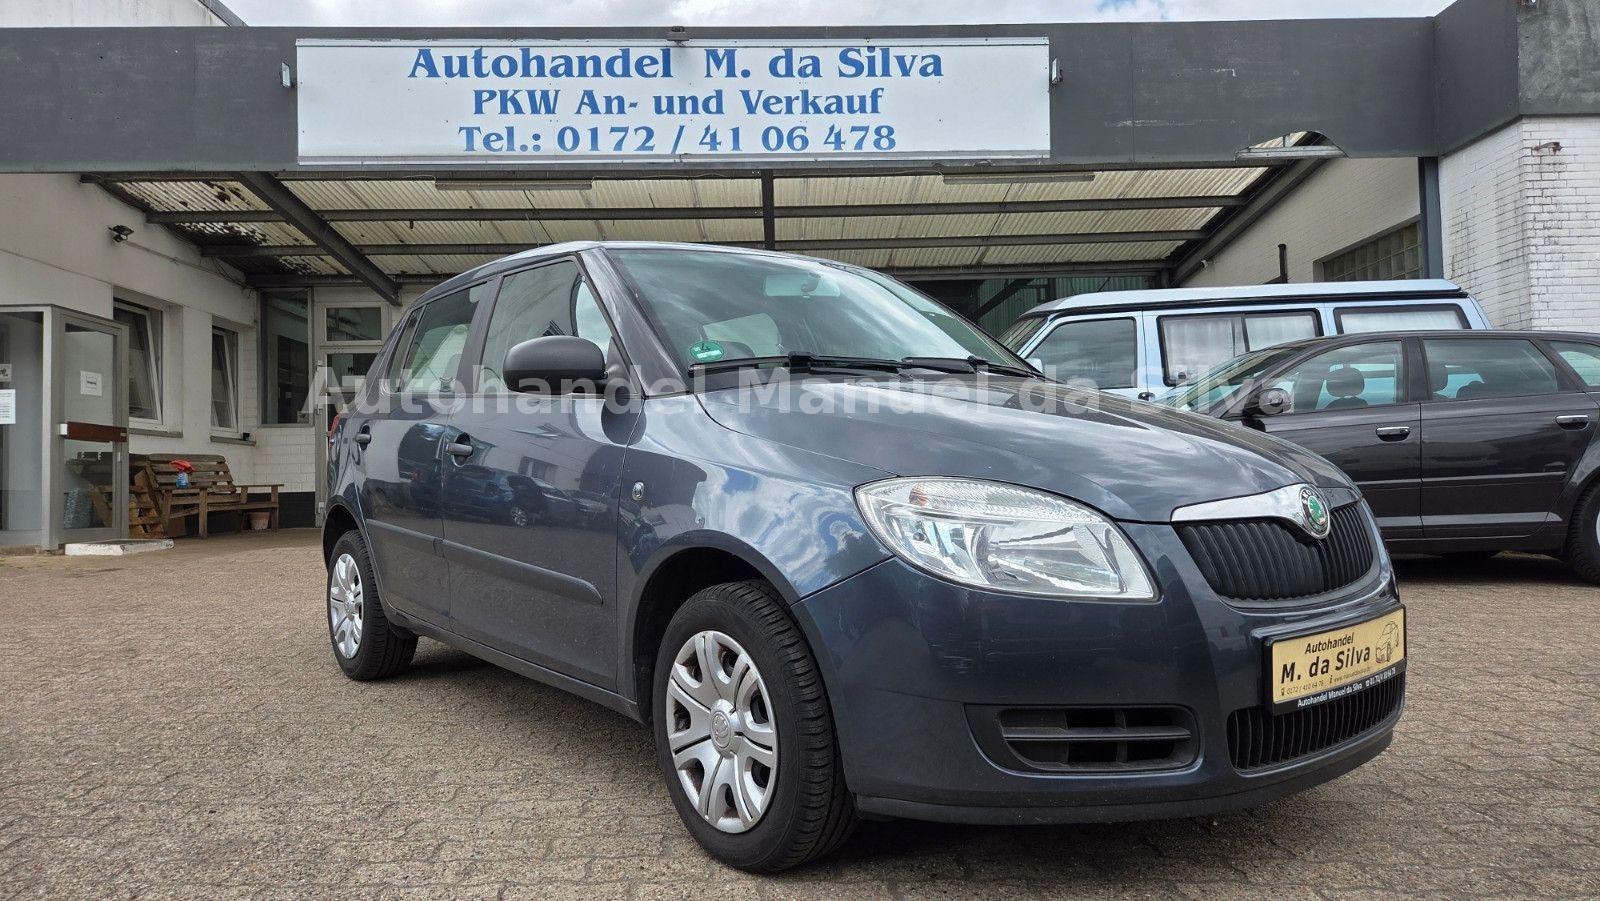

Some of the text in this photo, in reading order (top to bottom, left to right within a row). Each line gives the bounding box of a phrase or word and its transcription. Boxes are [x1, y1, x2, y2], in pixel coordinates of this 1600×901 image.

[408, 46, 944, 80] Autohandel M. da Silva
[472, 86, 884, 116] PKW An- und Verkauf
[458, 123, 897, 154] Tel.: 0172 / 41 06 478
[1305, 632, 1354, 654] Autohandel
[1281, 662, 1301, 684] M.
[1309, 656, 1330, 678] da
[1335, 646, 1370, 671] Silva
[1297, 682, 1363, 707] Autohandel Manuel da Silva
